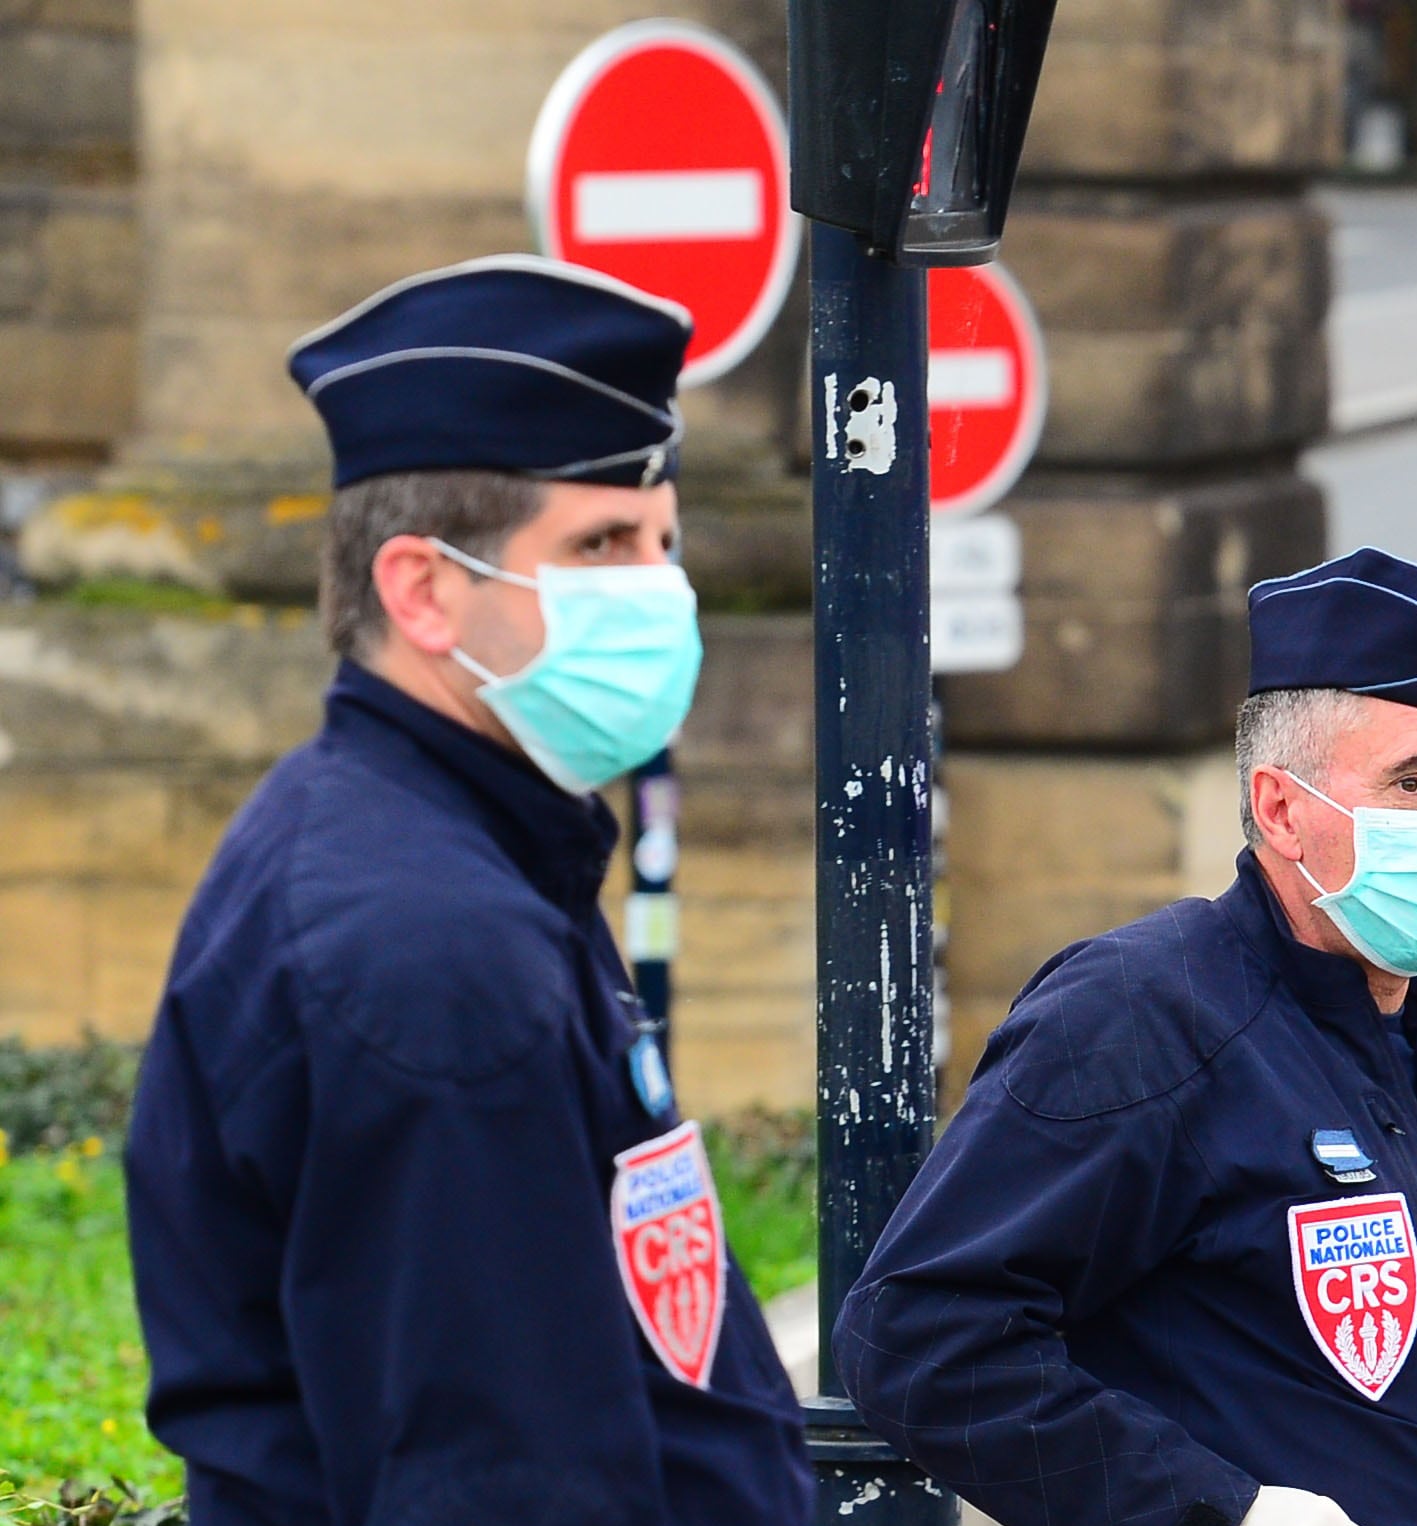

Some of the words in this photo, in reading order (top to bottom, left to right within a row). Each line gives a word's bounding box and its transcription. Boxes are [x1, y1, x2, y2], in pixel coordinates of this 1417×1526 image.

[633, 1205, 712, 1283] CRS
[1310, 1236, 1405, 1265] NATIONALE
[1316, 1218, 1395, 1245] POLICE
[1317, 1260, 1408, 1314] CRS
